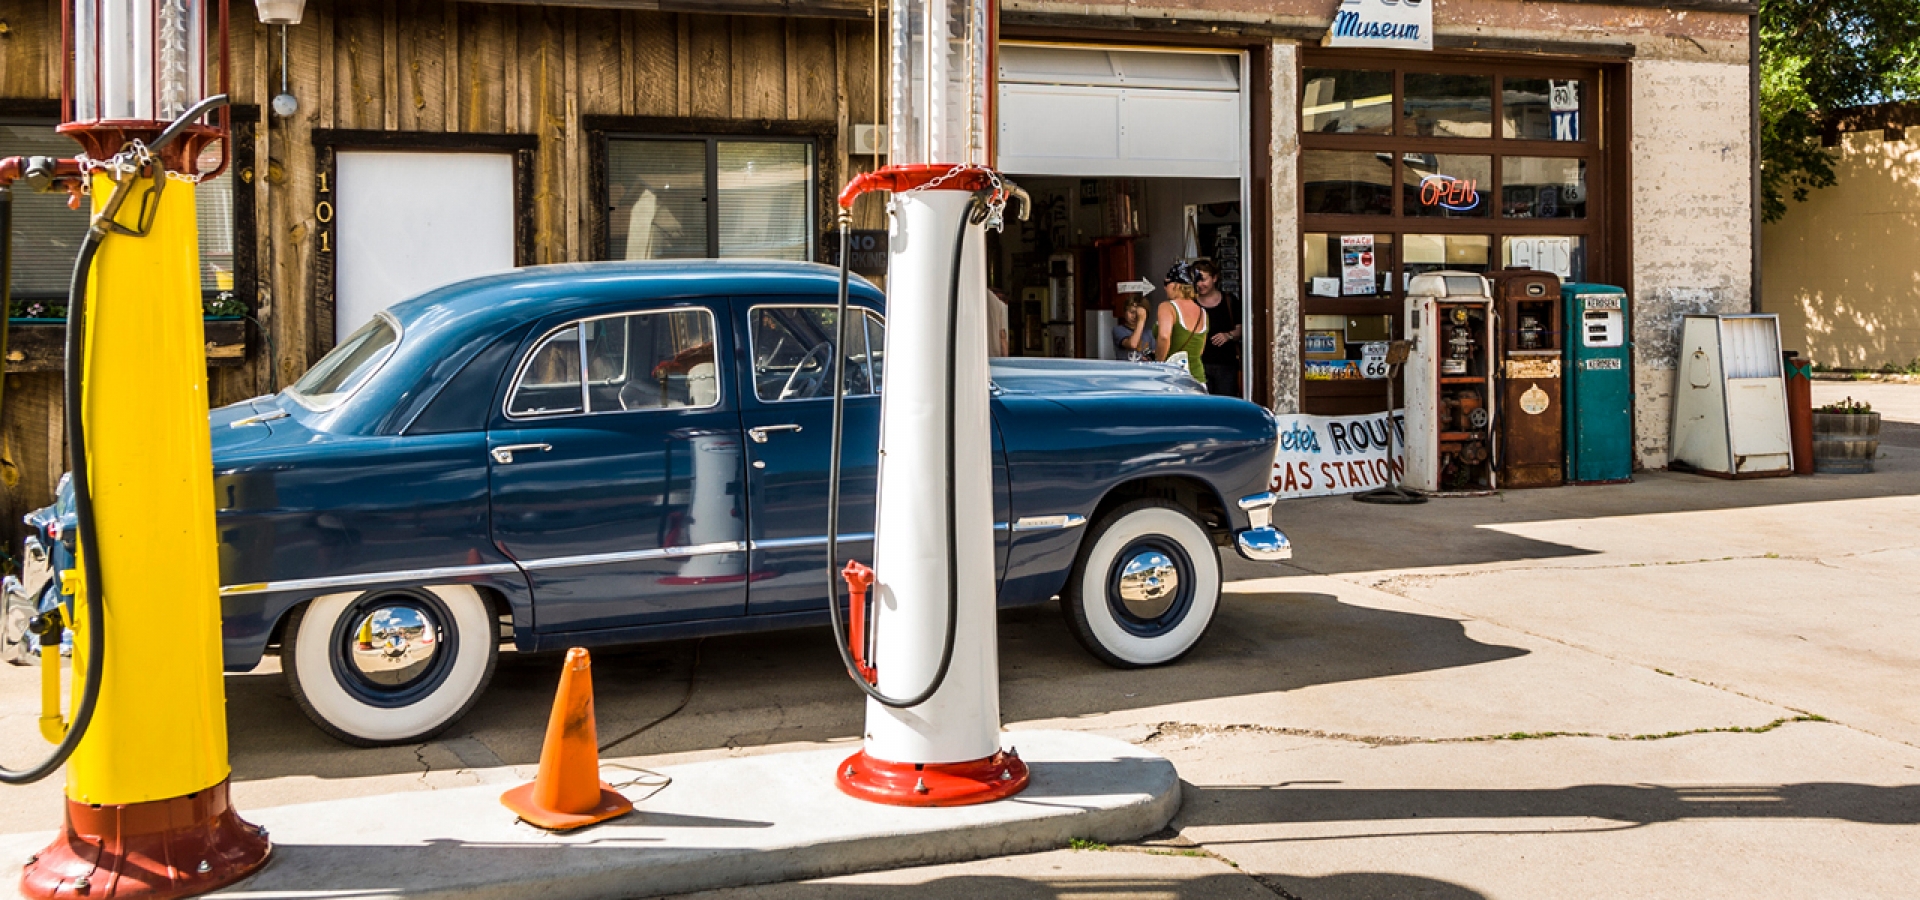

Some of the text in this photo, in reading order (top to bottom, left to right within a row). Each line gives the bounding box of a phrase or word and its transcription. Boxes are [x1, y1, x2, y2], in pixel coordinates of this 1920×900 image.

[1334, 10, 1420, 40] Museum
[1421, 179, 1477, 206] OPEN
[316, 171, 334, 253] 101
[849, 236, 875, 250] NO
[835, 252, 887, 267] PRKING
[1367, 362, 1386, 376] 66
[1279, 415, 1404, 455] ete's ROUT
[1269, 455, 1404, 493] GAS STATION
